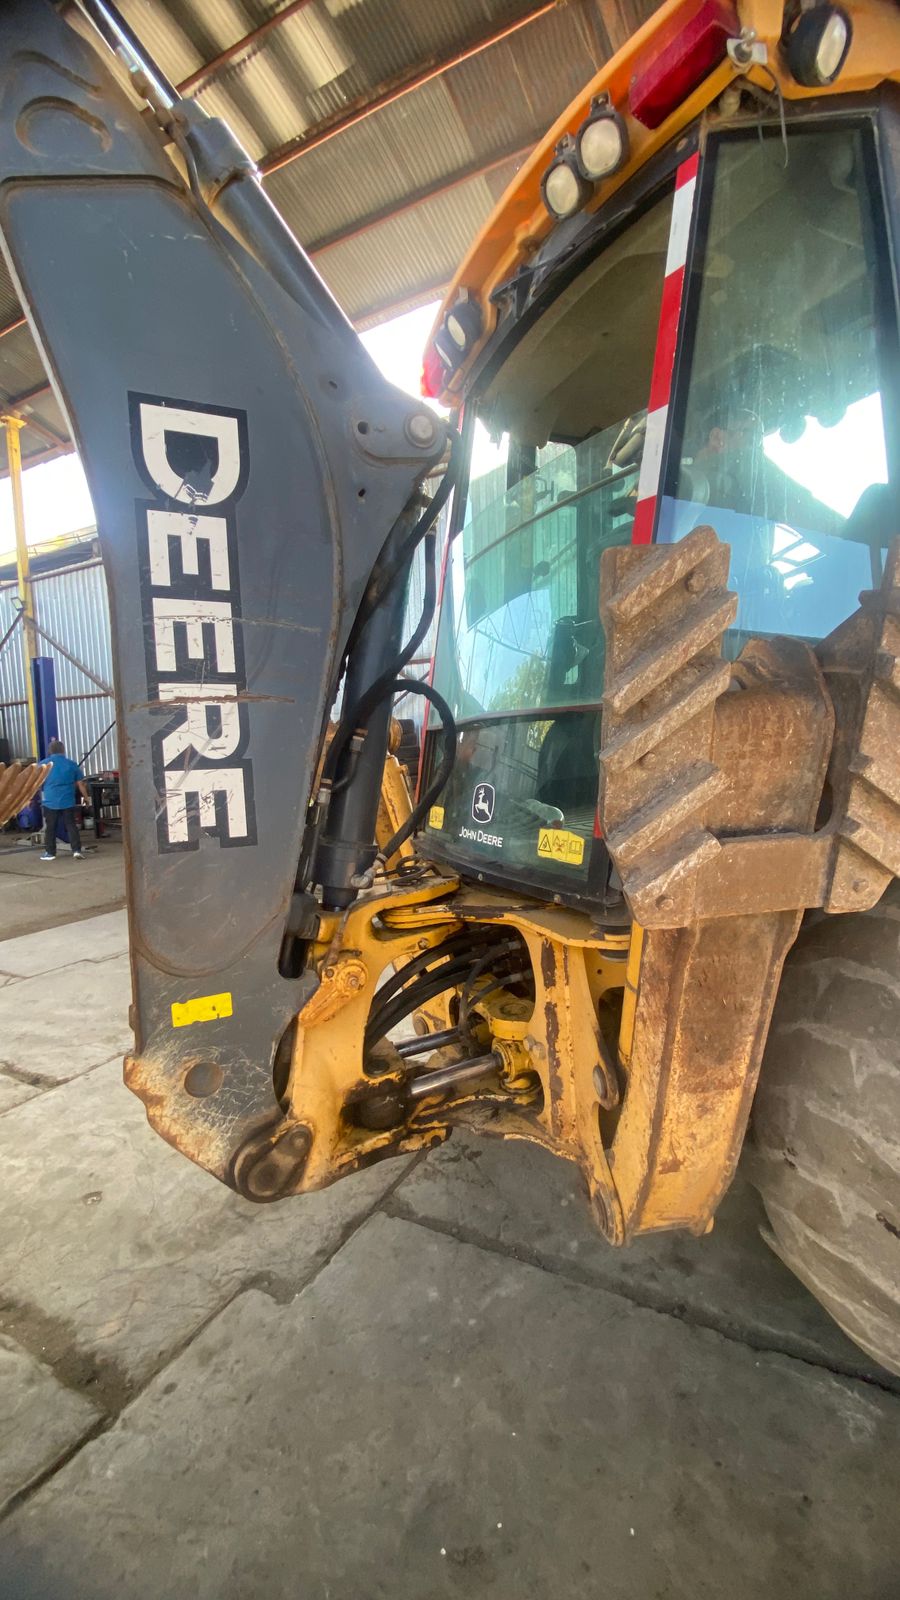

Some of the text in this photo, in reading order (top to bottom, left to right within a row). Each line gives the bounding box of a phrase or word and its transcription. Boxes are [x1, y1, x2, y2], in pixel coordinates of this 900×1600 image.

[139, 403, 249, 844] DEERE
[459, 826, 503, 848] JOHN DEERE
